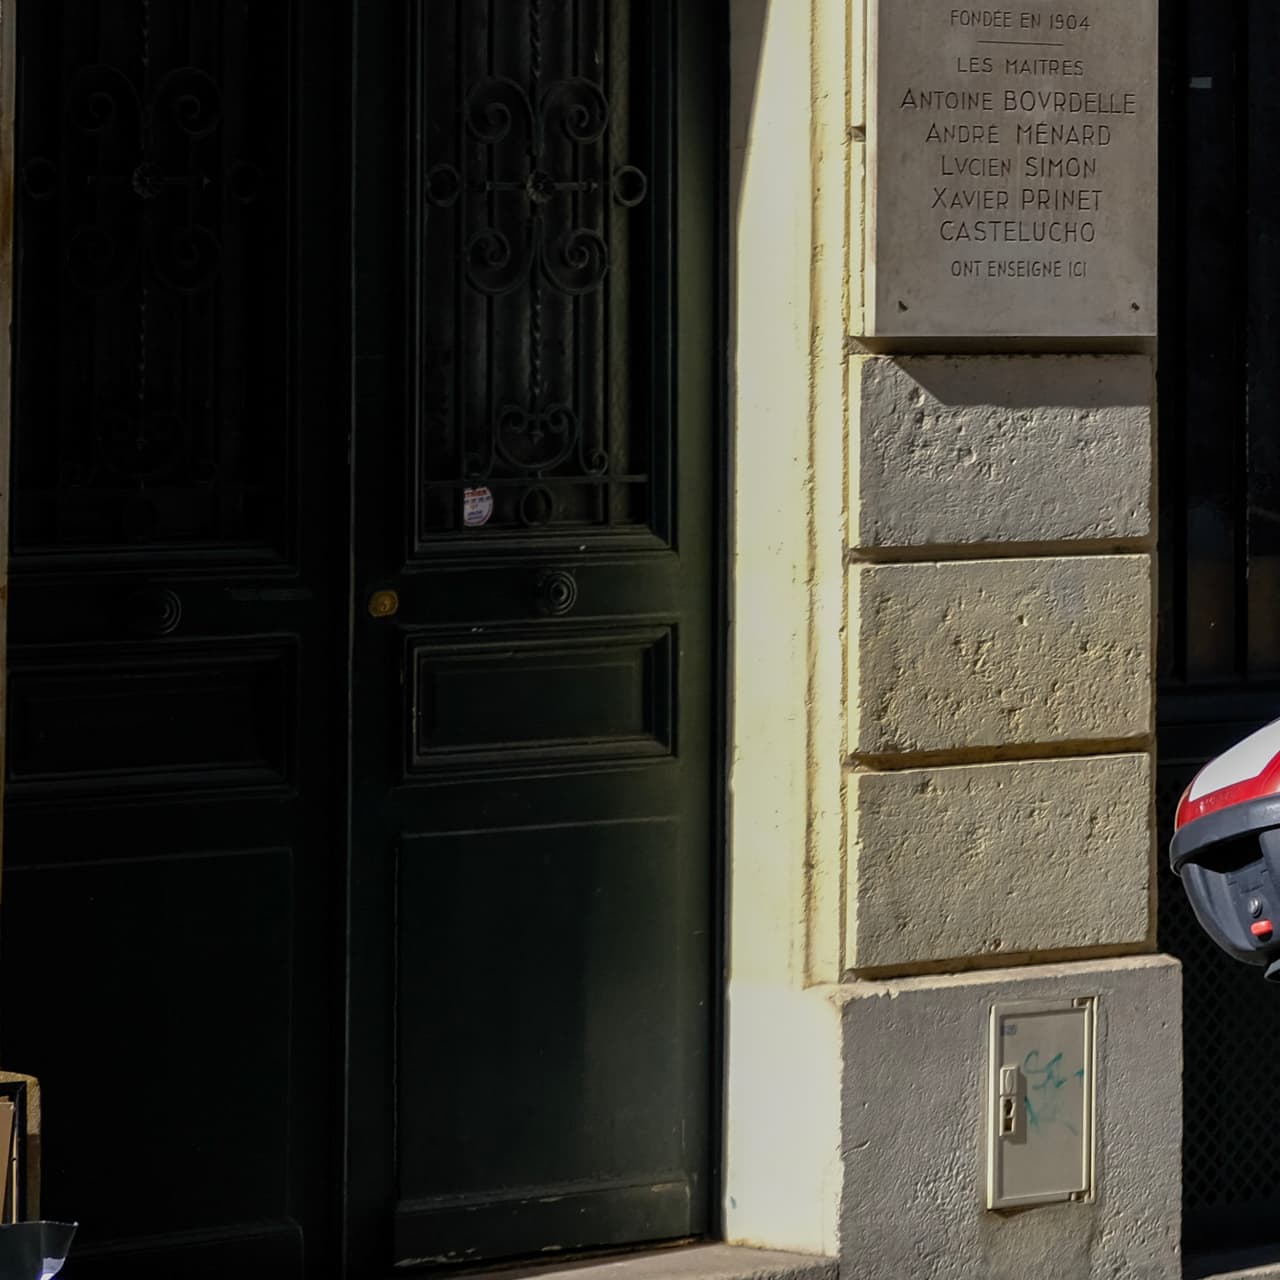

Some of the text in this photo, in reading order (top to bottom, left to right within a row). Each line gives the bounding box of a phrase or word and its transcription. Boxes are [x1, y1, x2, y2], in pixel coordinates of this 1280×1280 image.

[1020, 11, 1041, 29] EN
[1049, 13, 1091, 32] 1904
[957, 57, 1085, 77] LES MAITRES
[899, 88, 993, 112] ANTOINE
[1016, 120, 1112, 146] MÉNARD
[1025, 156, 1097, 179] SIMON
[930, 186, 1104, 211] XAVIER PRINET
[939, 220, 1096, 243] CASTELUCHO
[950, 260, 982, 277] ONT
[1068, 261, 1087, 278] ICI
